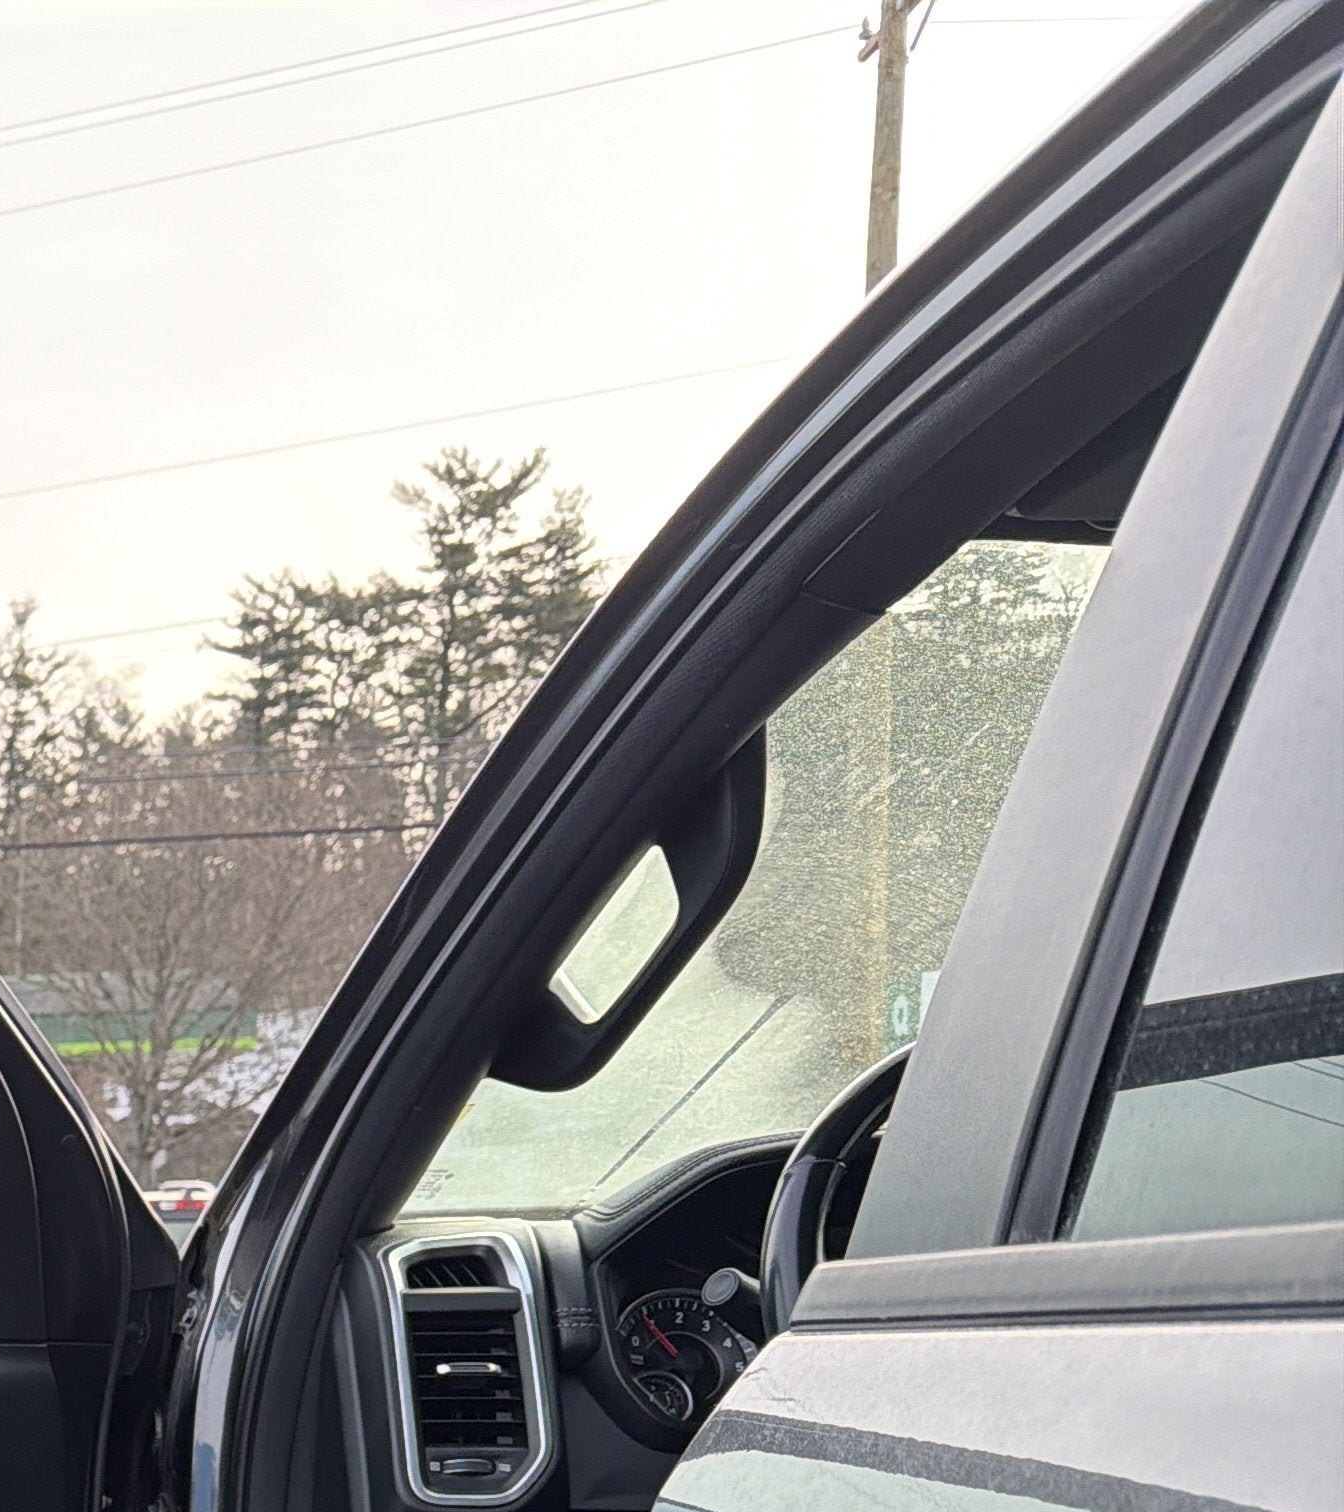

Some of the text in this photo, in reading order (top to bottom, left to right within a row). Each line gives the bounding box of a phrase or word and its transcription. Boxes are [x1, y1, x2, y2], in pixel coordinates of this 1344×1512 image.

[674, 1311, 685, 1324] 2
[701, 1319, 712, 1332] 3
[631, 1335, 641, 1347] 0
[722, 1337, 733, 1348] 4
[734, 1361, 745, 1373] 5
